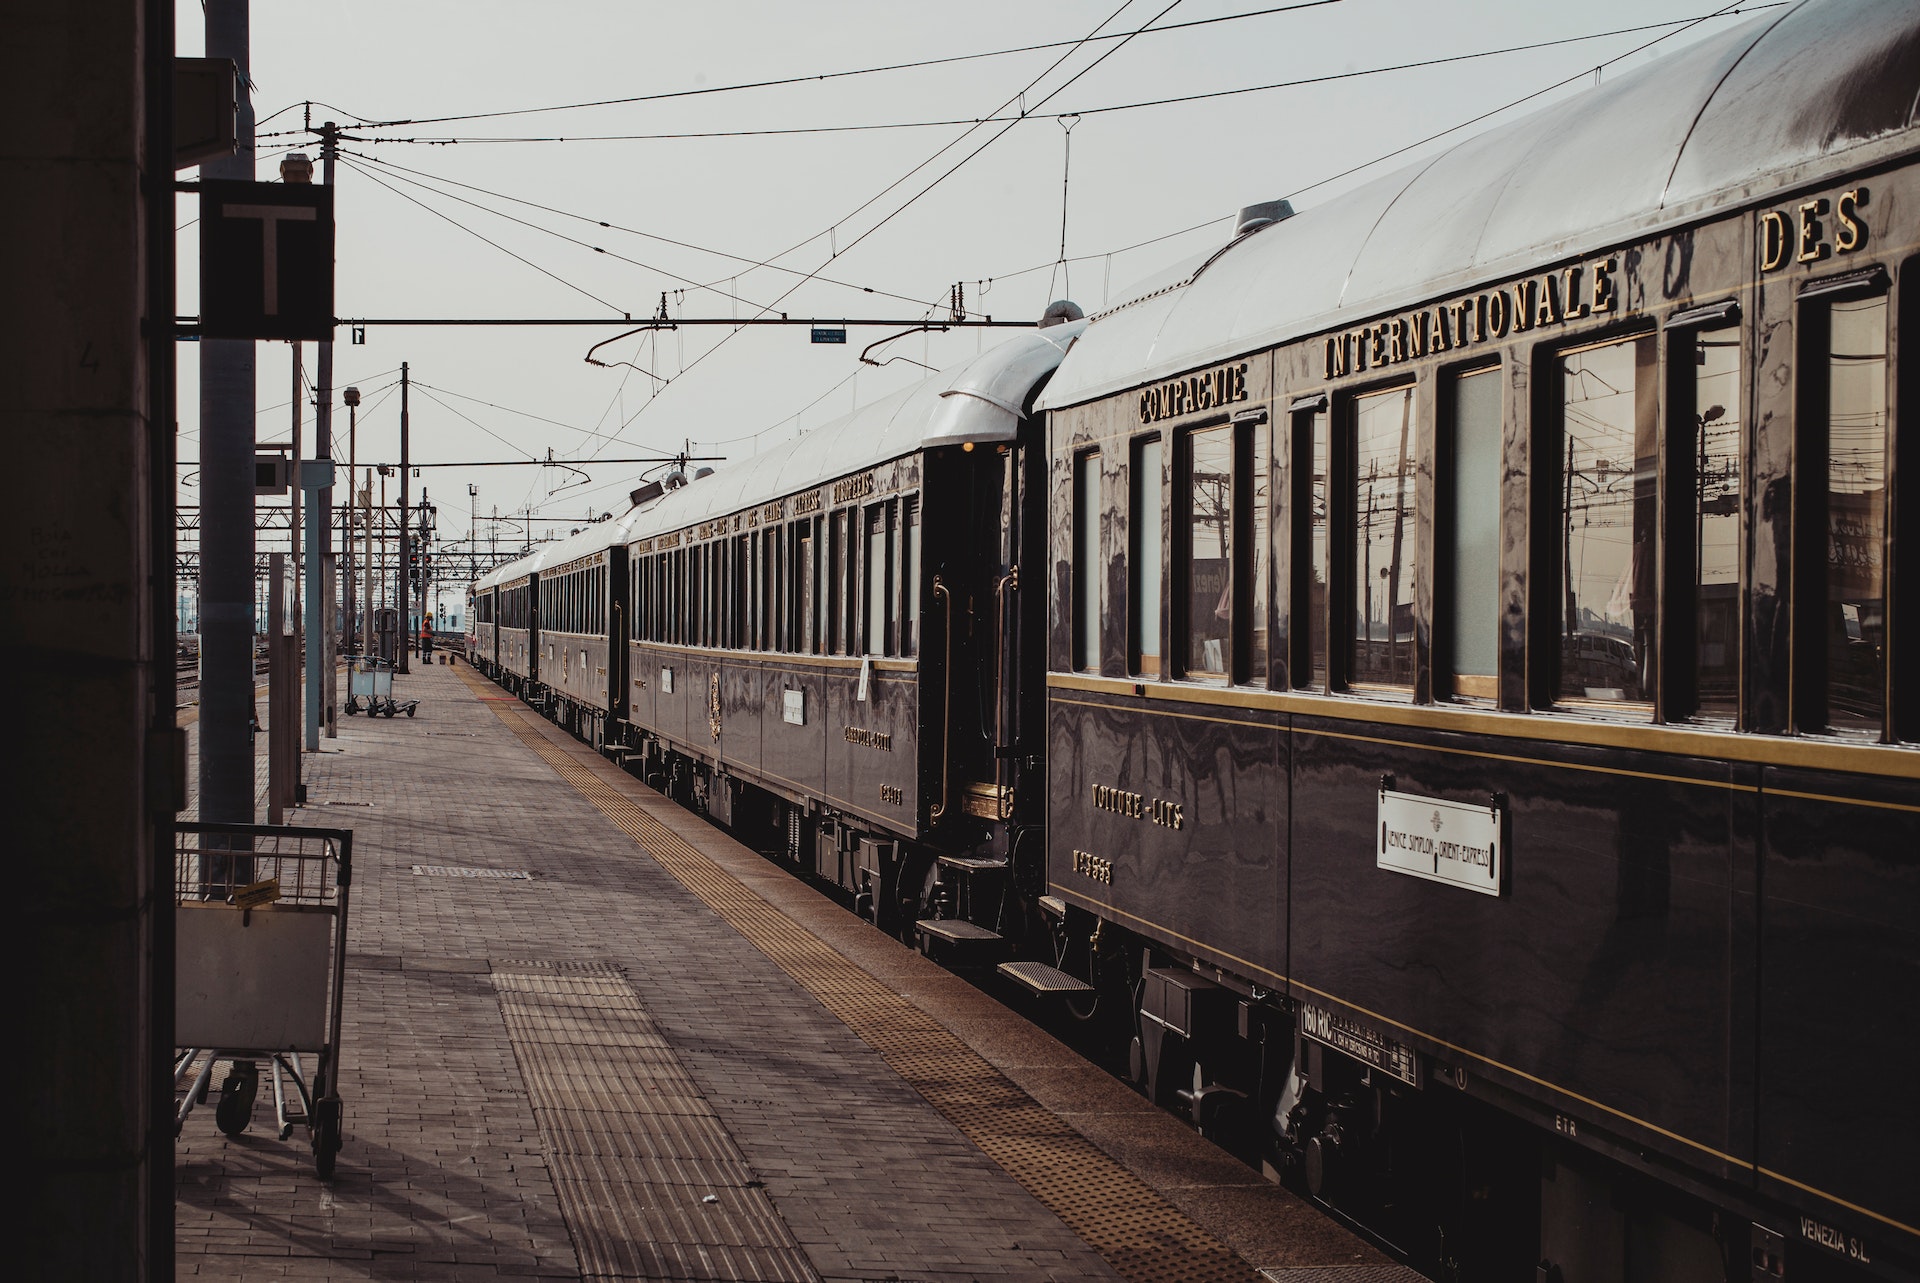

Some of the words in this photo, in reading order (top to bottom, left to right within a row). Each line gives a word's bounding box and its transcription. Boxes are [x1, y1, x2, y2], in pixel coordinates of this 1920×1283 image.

[222, 203, 317, 315] T
[1139, 364, 1246, 423] COMPAGNIE
[1322, 260, 1614, 381] INTERNATIONALE
[1760, 188, 1866, 273] DES
[1555, 1114, 1576, 1137] ETR
[1800, 1216, 1845, 1253] VENEZIA
[1849, 1237, 1870, 1264] S.L.
